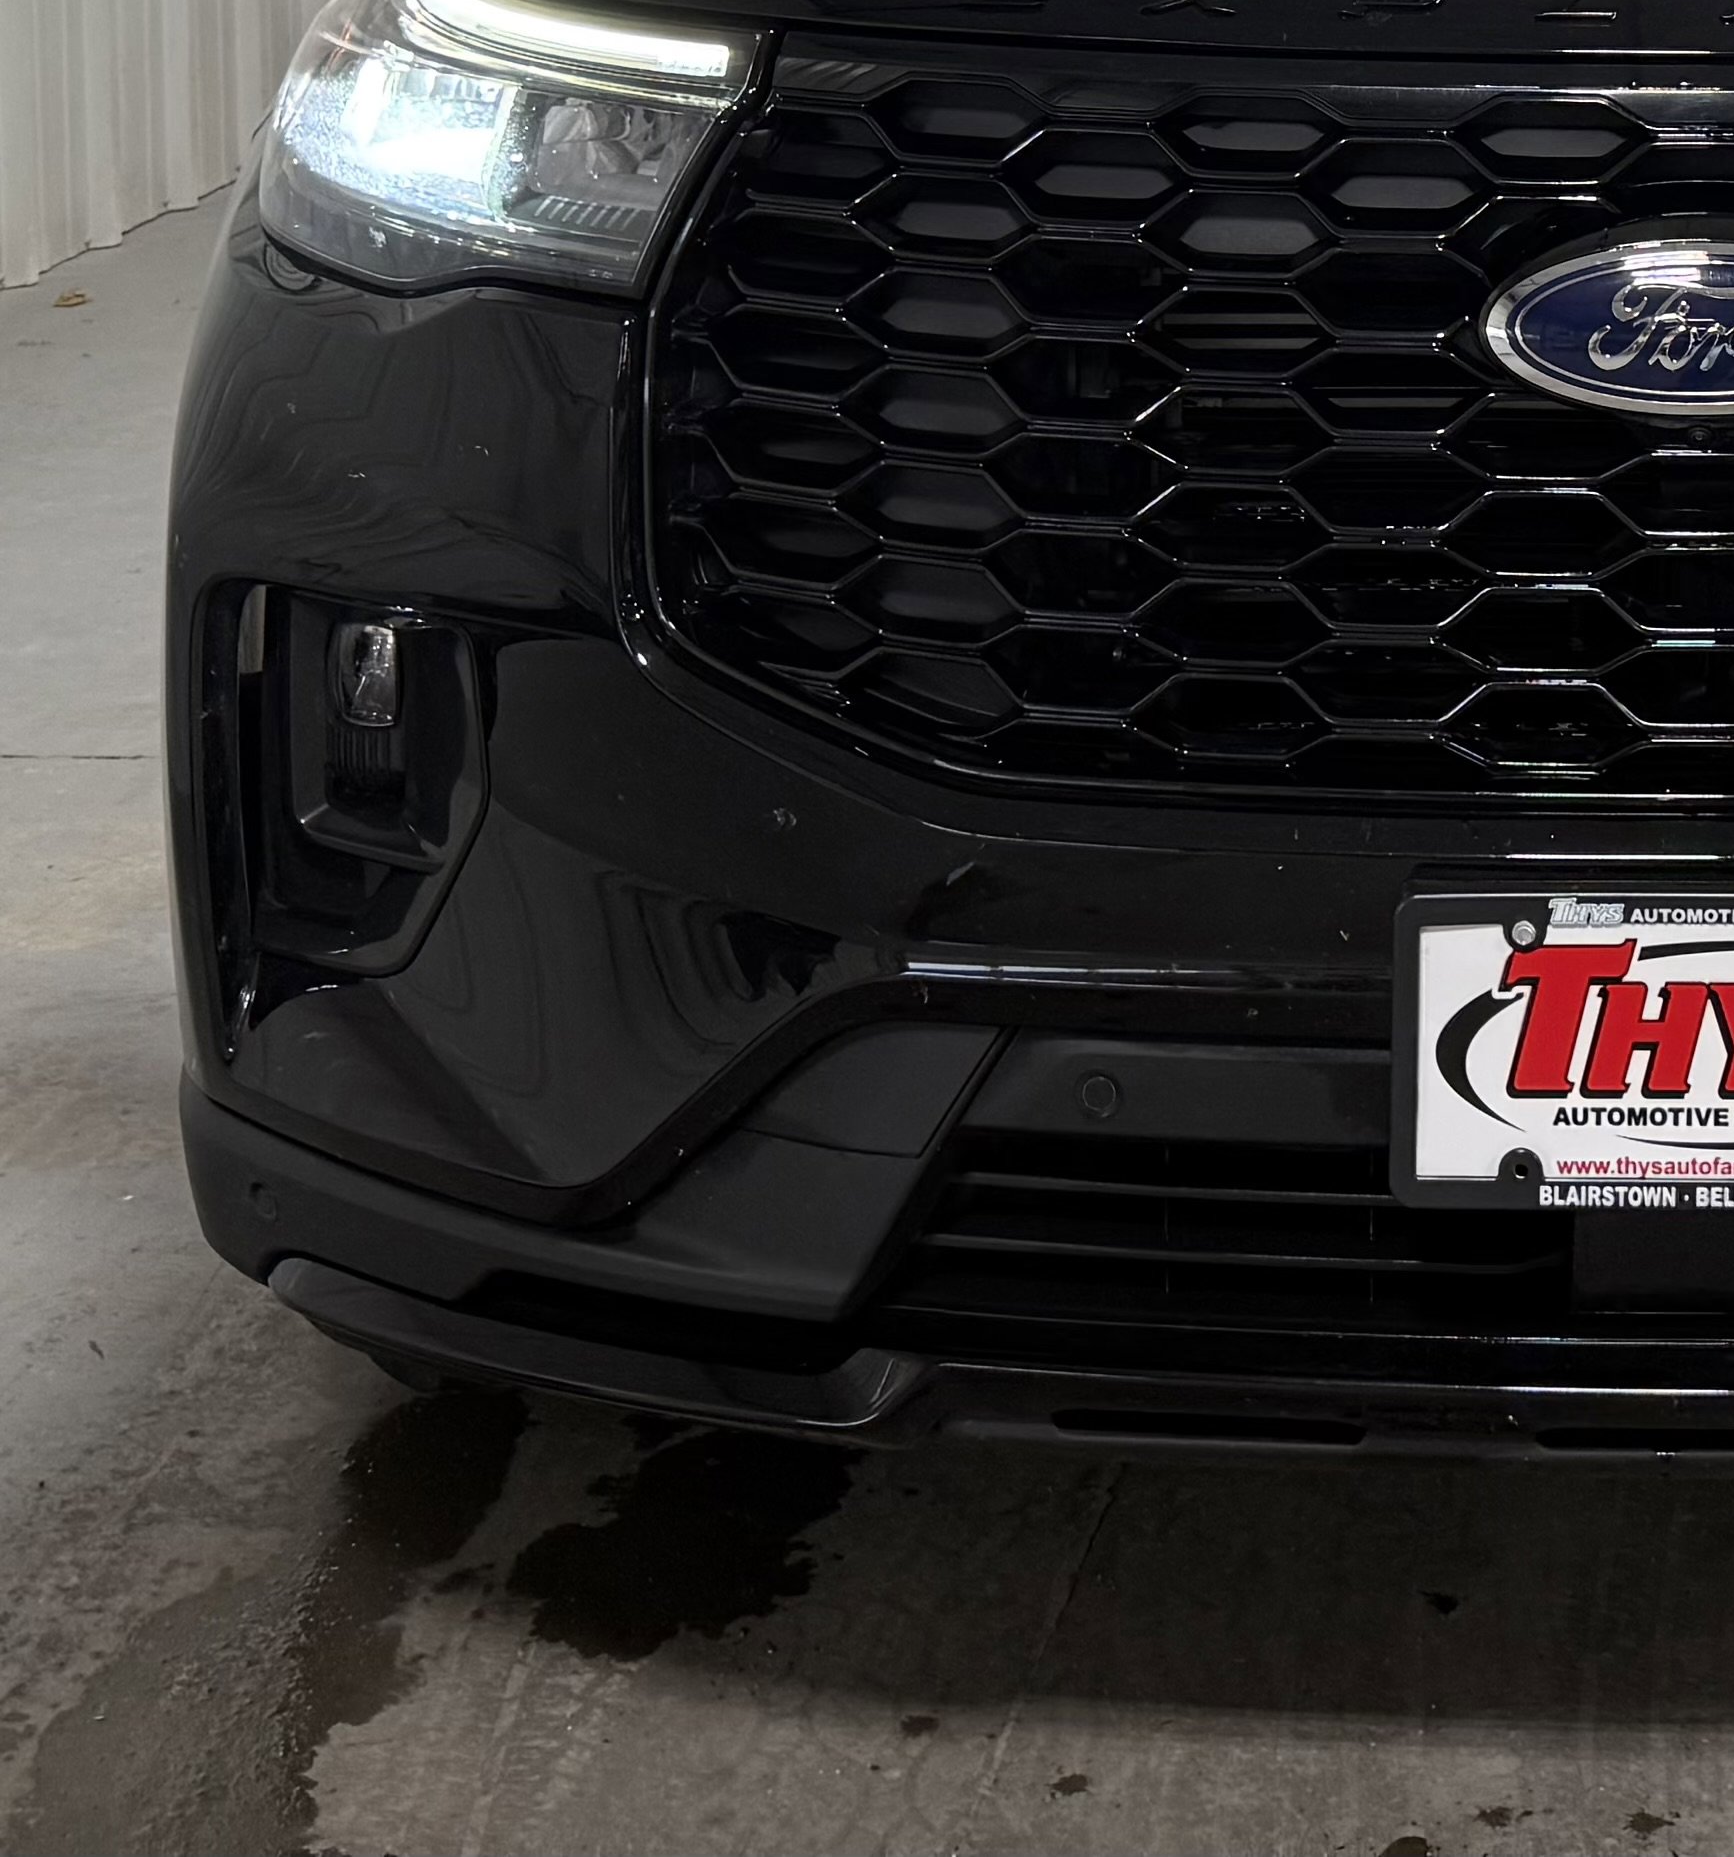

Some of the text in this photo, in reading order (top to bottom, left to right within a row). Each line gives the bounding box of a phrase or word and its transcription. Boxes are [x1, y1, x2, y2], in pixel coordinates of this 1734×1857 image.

[1548, 897, 1625, 927] THYS
[1553, 1106, 1730, 1127] AUTOMOTIVE
[1539, 1185, 1677, 1207] BLAIRSTOWN
